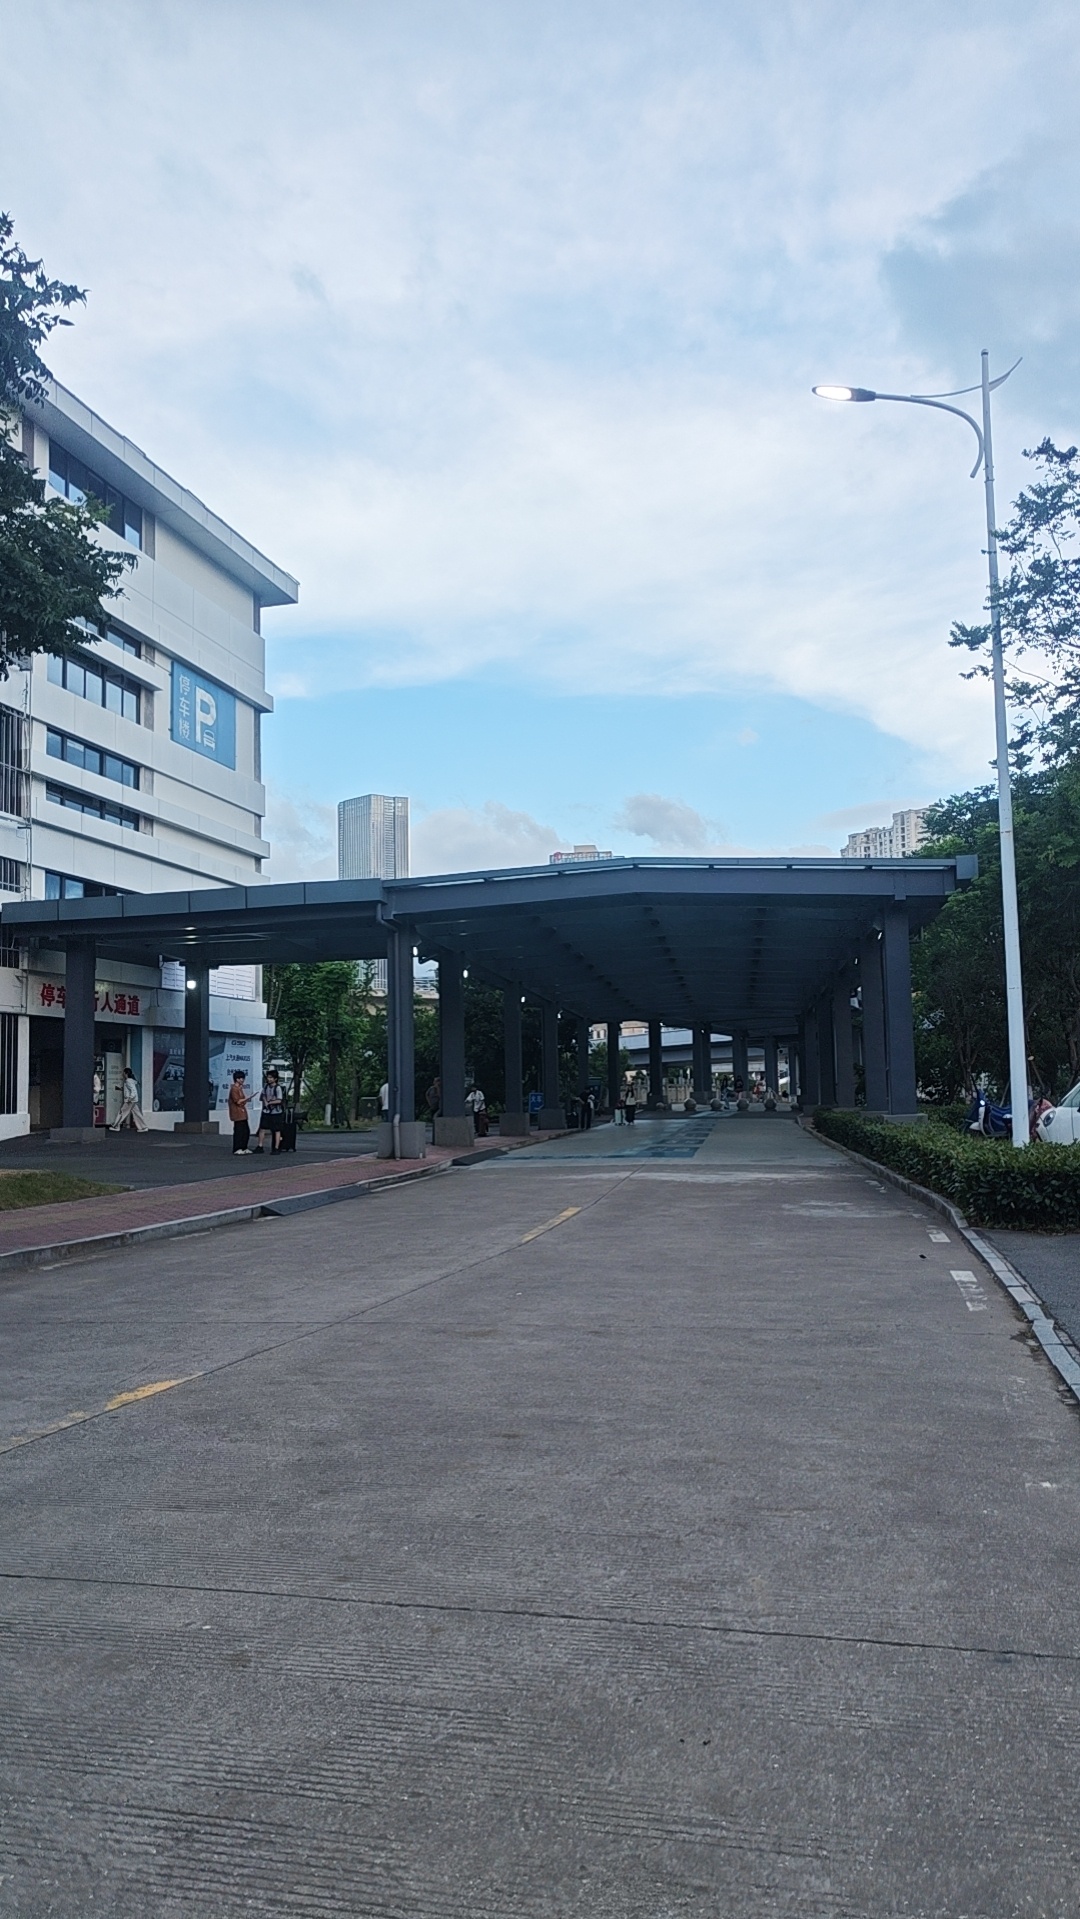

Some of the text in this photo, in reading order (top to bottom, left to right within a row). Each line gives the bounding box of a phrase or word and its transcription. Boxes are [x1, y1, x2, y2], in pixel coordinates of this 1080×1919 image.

[179, 673, 191, 741] 停车楼
[195, 685, 217, 744] P
[40, 983, 140, 1016] 停车人通道
